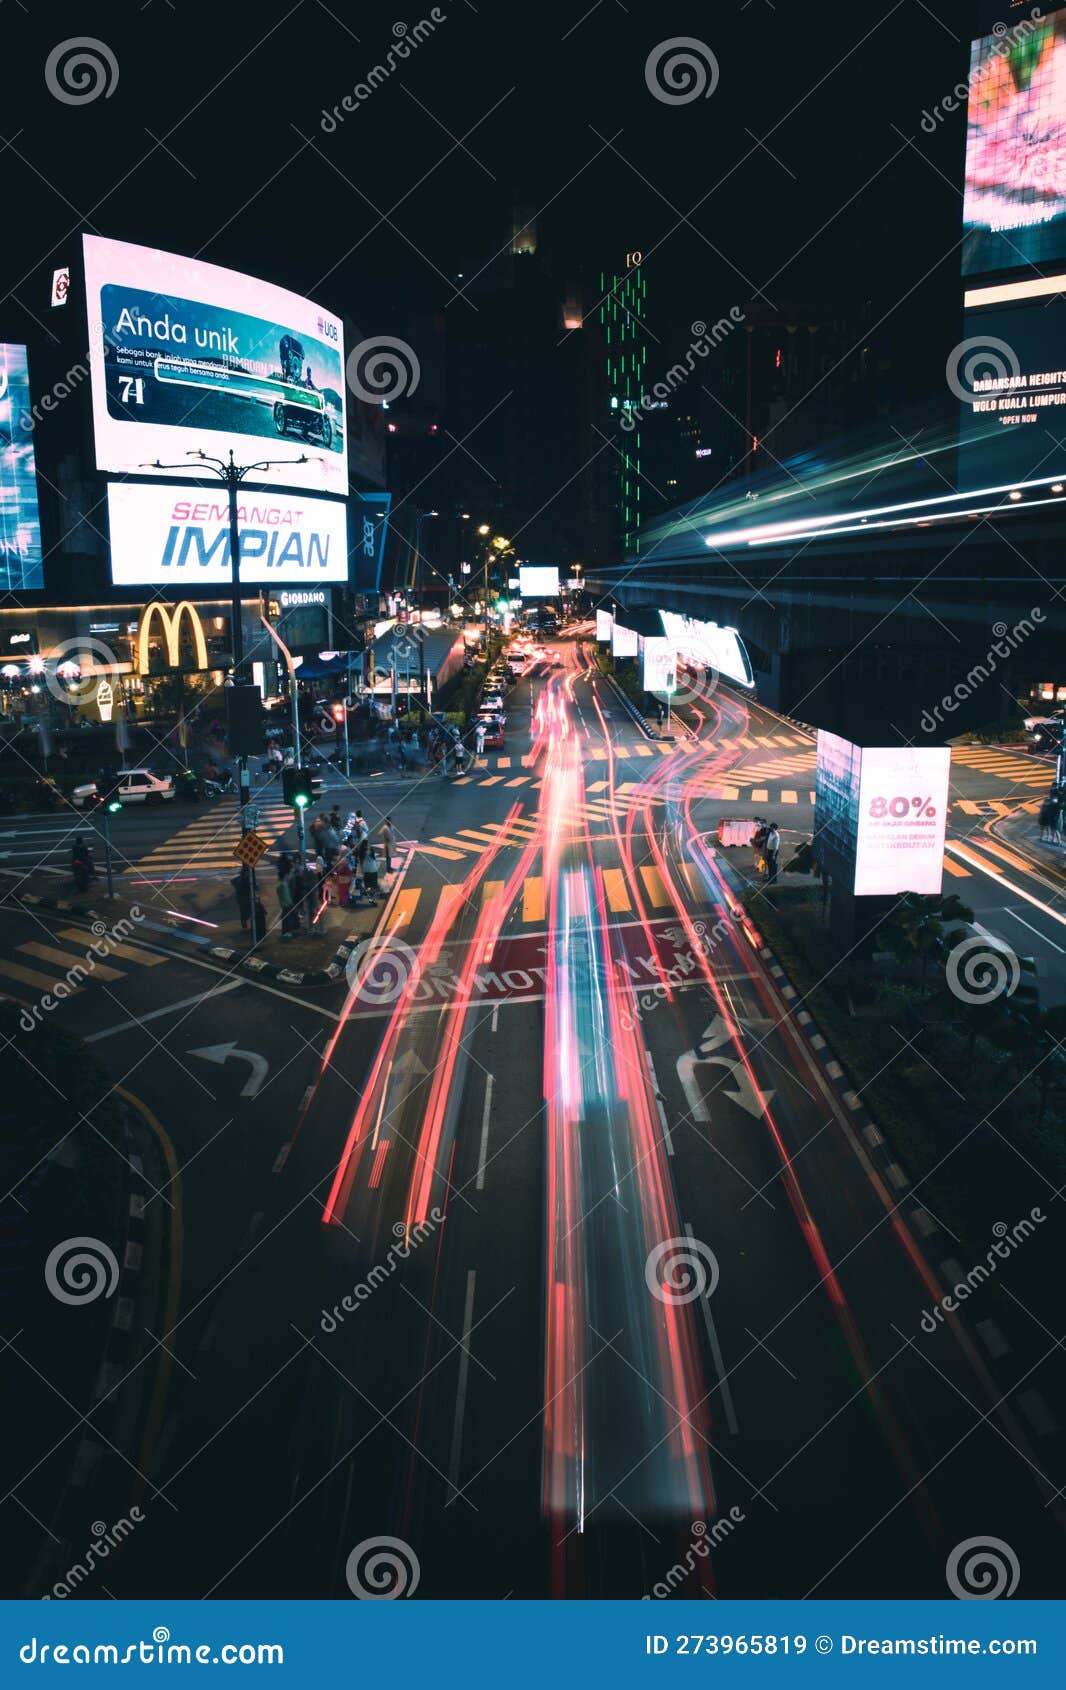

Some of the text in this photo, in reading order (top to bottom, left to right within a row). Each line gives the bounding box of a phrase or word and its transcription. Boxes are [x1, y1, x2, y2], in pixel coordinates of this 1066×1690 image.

[116, 308, 239, 354] Anda unik
[116, 346, 145, 358] Sebagai
[116, 356, 133, 364] kami
[134, 359, 153, 367] untuk
[155, 362, 171, 370] erus
[998, 396, 1027, 410] KUALA
[1029, 393, 1066, 408] LUMPUR
[1021, 414, 1038, 423] NOW
[172, 502, 304, 526] SEMANGAT
[363, 515, 375, 558] acer
[161, 526, 330, 568] IMPIAN
[281, 591, 325, 606] GIORDANO
[868, 796, 937, 819] 80%
